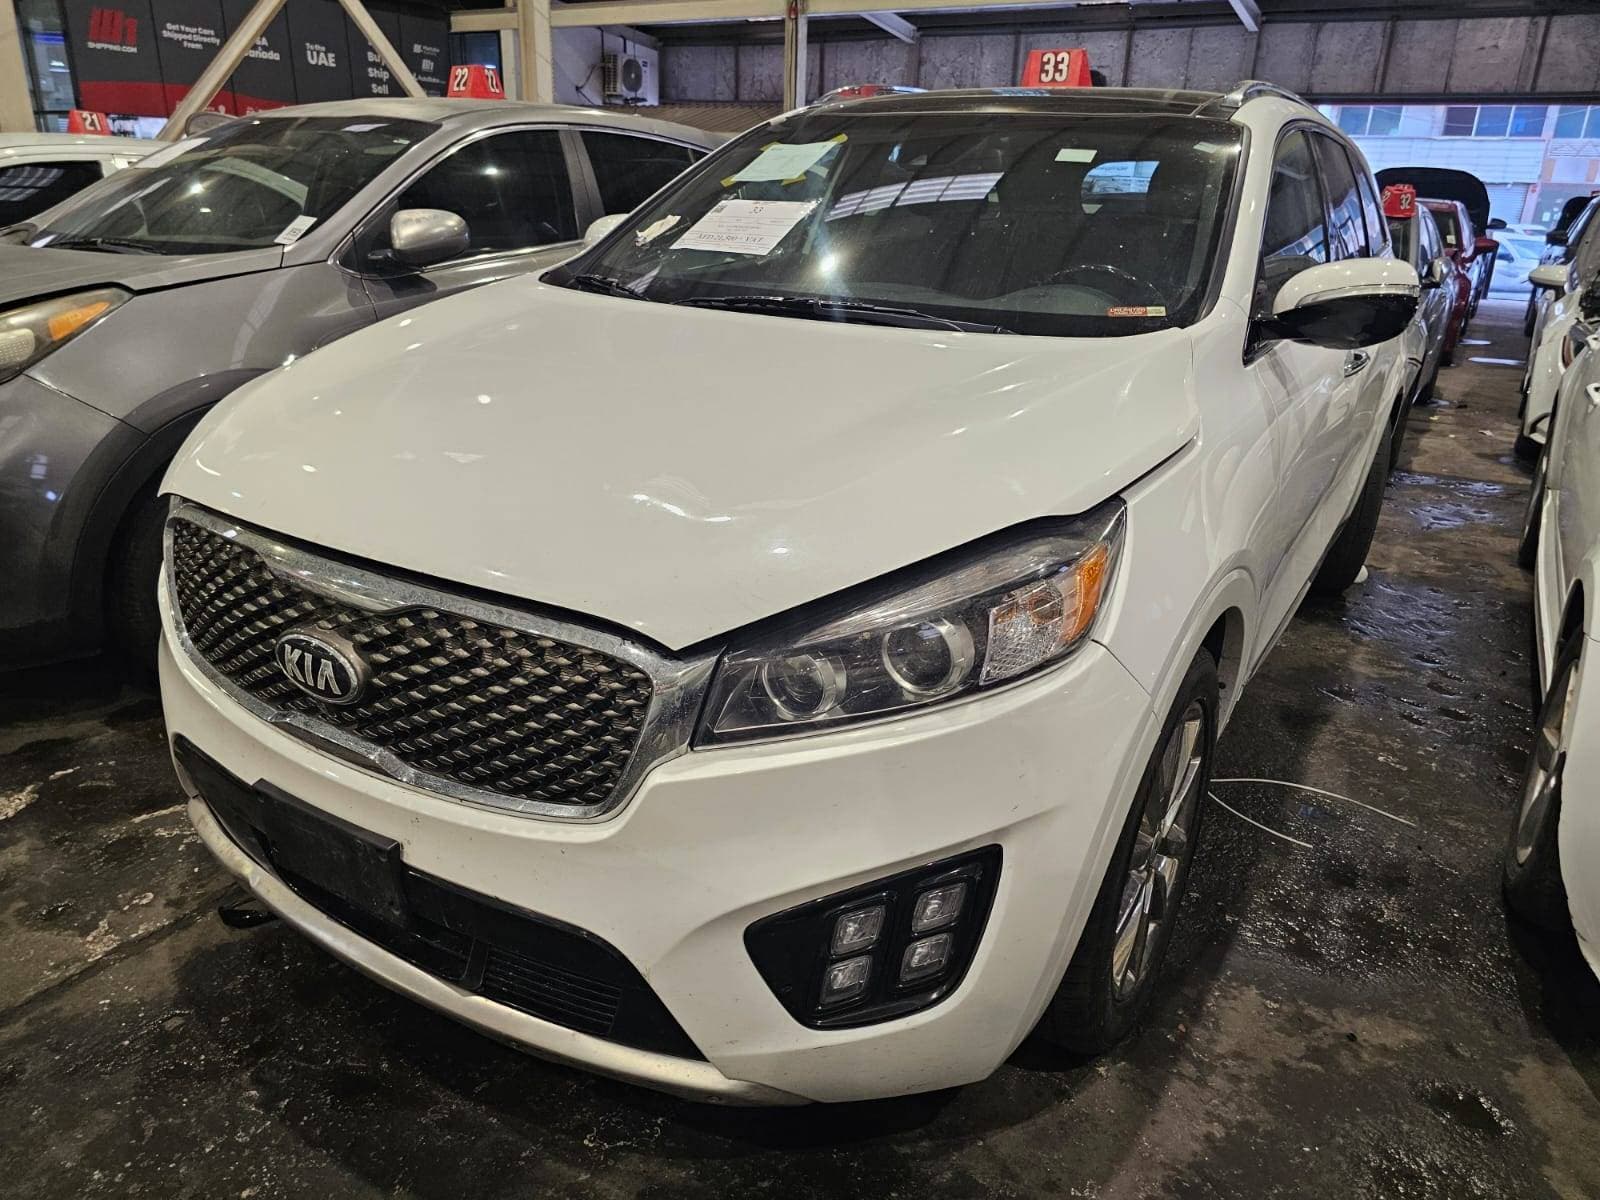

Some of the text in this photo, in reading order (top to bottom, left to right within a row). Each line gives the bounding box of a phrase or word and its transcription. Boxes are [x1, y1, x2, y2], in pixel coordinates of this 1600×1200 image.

[162, 29, 220, 46] Shipped Directly
[180, 24, 197, 33] Your
[198, 27, 215, 36] Cars
[183, 40, 203, 50] From
[305, 42, 326, 52] To the
[306, 50, 336, 67] UAE
[367, 67, 390, 82] Ship
[1041, 51, 1070, 83] 33
[453, 67, 469, 91] 22
[371, 83, 389, 95] Sell
[82, 112, 101, 131] 21
[1400, 193, 1411, 209] 32
[284, 643, 342, 695] KIA
